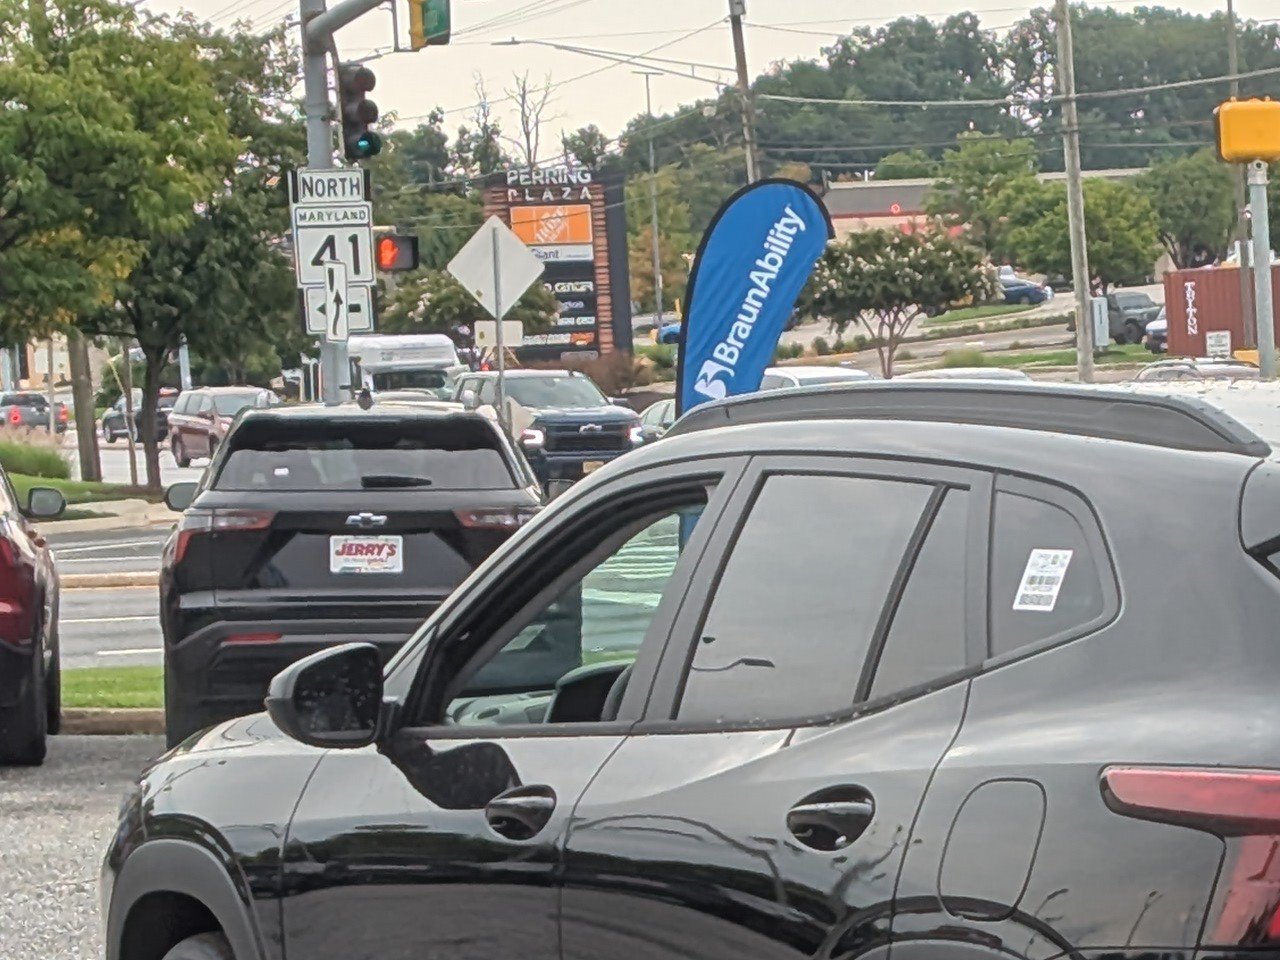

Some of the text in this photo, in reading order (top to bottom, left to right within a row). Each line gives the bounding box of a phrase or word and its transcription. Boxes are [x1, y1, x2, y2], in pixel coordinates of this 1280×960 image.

[506, 165, 592, 186] PERRING
[301, 176, 361, 198] NORTH
[507, 186, 592, 202] PLAZA
[299, 209, 366, 222] MARYLAND
[311, 233, 361, 275] 41
[713, 203, 806, 367] BraunAbility
[335, 543, 397, 557] JERRY'S
